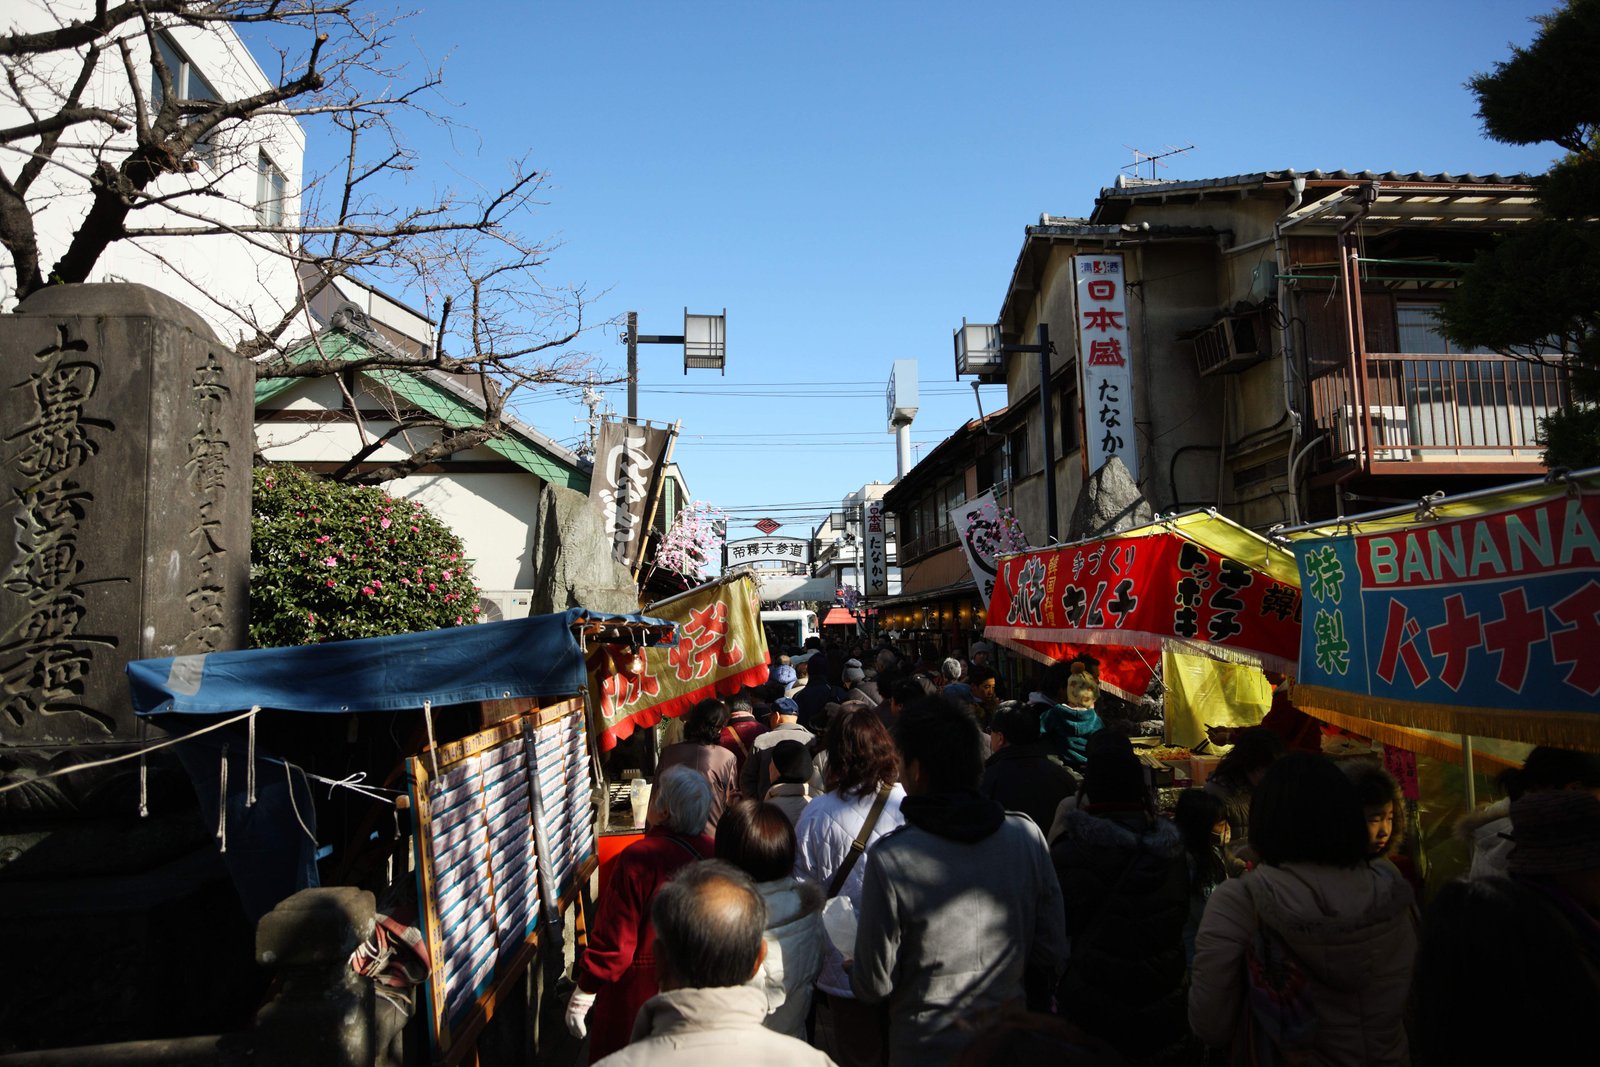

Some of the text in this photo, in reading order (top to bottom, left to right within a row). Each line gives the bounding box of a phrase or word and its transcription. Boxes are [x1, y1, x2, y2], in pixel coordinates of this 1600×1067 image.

[1084, 279, 1126, 367] 日本盛
[1098, 378, 1124, 460] たなか
[870, 535, 884, 591] たなかや
[1071, 544, 1137, 581] 手づくり
[1368, 499, 1600, 584] BANANA
[1061, 578, 1139, 629] キムチ
[1207, 558, 1254, 641] キムチ
[1260, 582, 1302, 624] 韓
[1304, 545, 1350, 676] 特製
